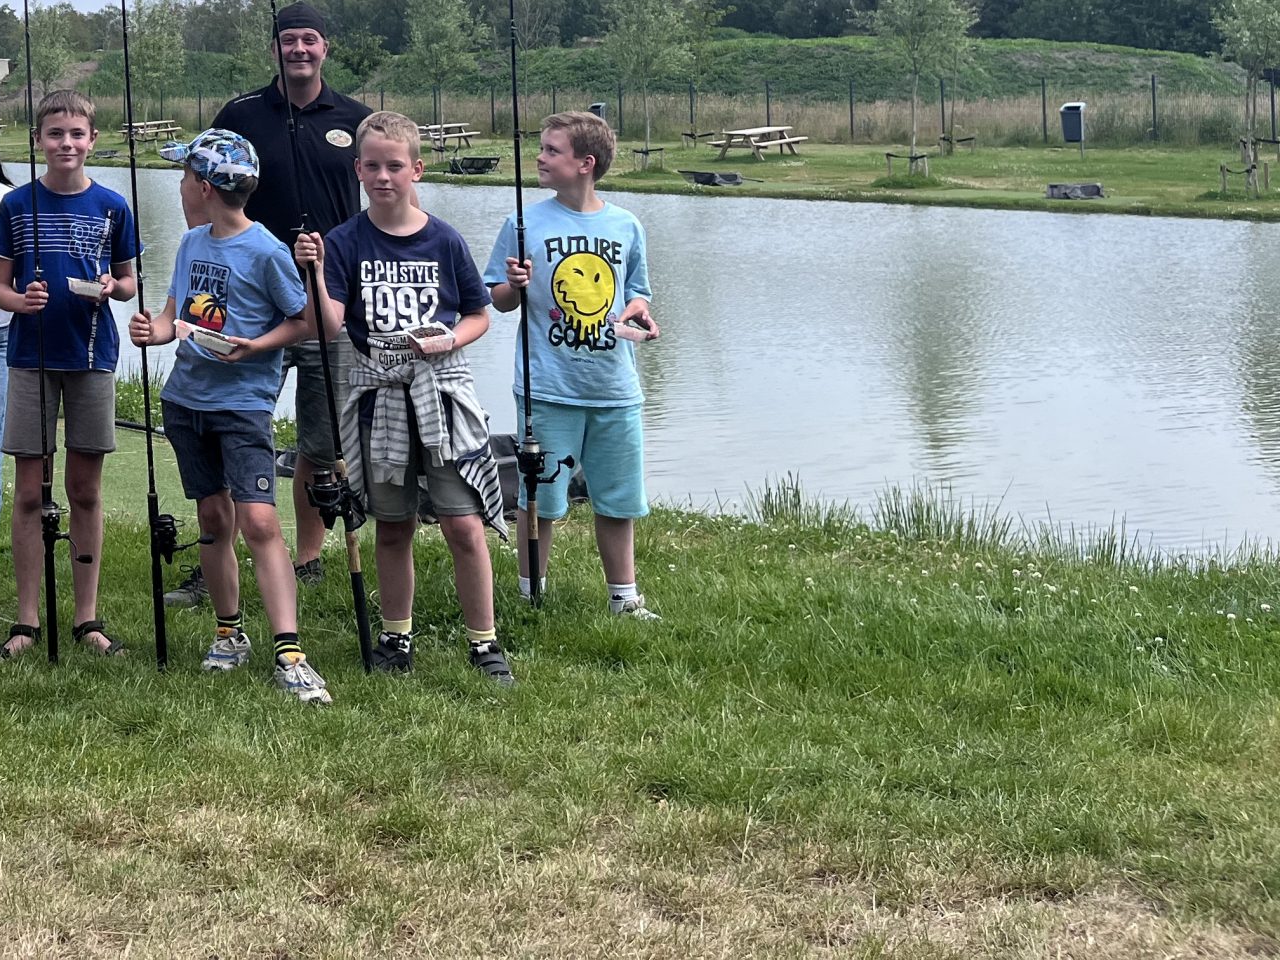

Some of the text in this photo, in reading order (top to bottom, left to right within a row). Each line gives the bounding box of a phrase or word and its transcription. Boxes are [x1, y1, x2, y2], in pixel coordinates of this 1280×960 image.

[544, 235, 622, 265] FUTURE
[211, 266, 227, 280] THE
[361, 260, 439, 283] CPH STYLE
[191, 275, 224, 295] WAVE
[361, 285, 439, 332] 1992
[548, 323, 618, 352] GOALS
